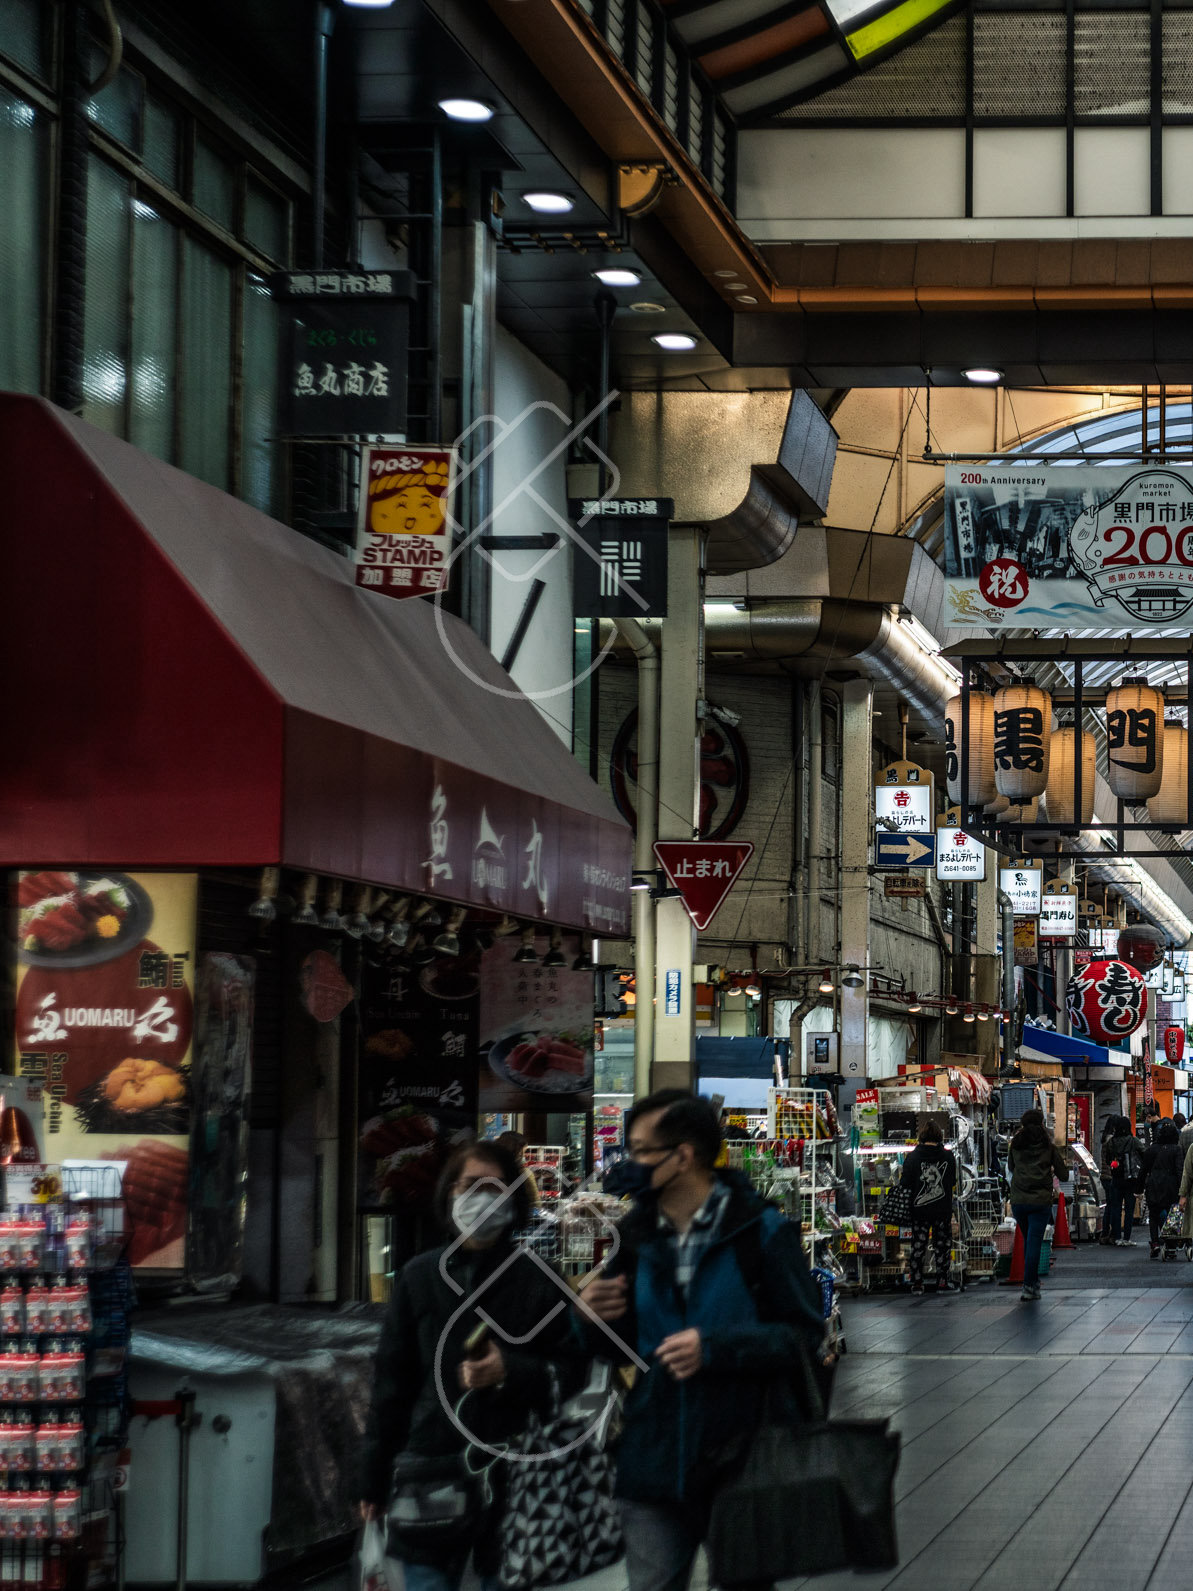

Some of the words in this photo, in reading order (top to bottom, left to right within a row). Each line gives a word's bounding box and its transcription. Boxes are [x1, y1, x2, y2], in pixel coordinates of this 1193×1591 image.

[289, 274, 392, 293] 黒門市場
[294, 361, 389, 397] 魚丸商店
[372, 456, 423, 475] クロモン
[960, 473, 989, 485] 200th
[990, 476, 1046, 486] Anniversary
[582, 500, 657, 515] 黒門市場
[371, 534, 435, 550] フレッシュ
[362, 548, 443, 566] STAMP
[361, 567, 442, 588] 加盟店
[986, 565, 1025, 600] 祝
[886, 768, 919, 783] 黒門
[939, 852, 982, 863] まるよしデパート
[673, 858, 733, 878] 止まれ
[171, 951, 190, 990] Tuna
[64, 1007, 136, 1028] UOMARU
[51, 1051, 69, 1081] Sea
